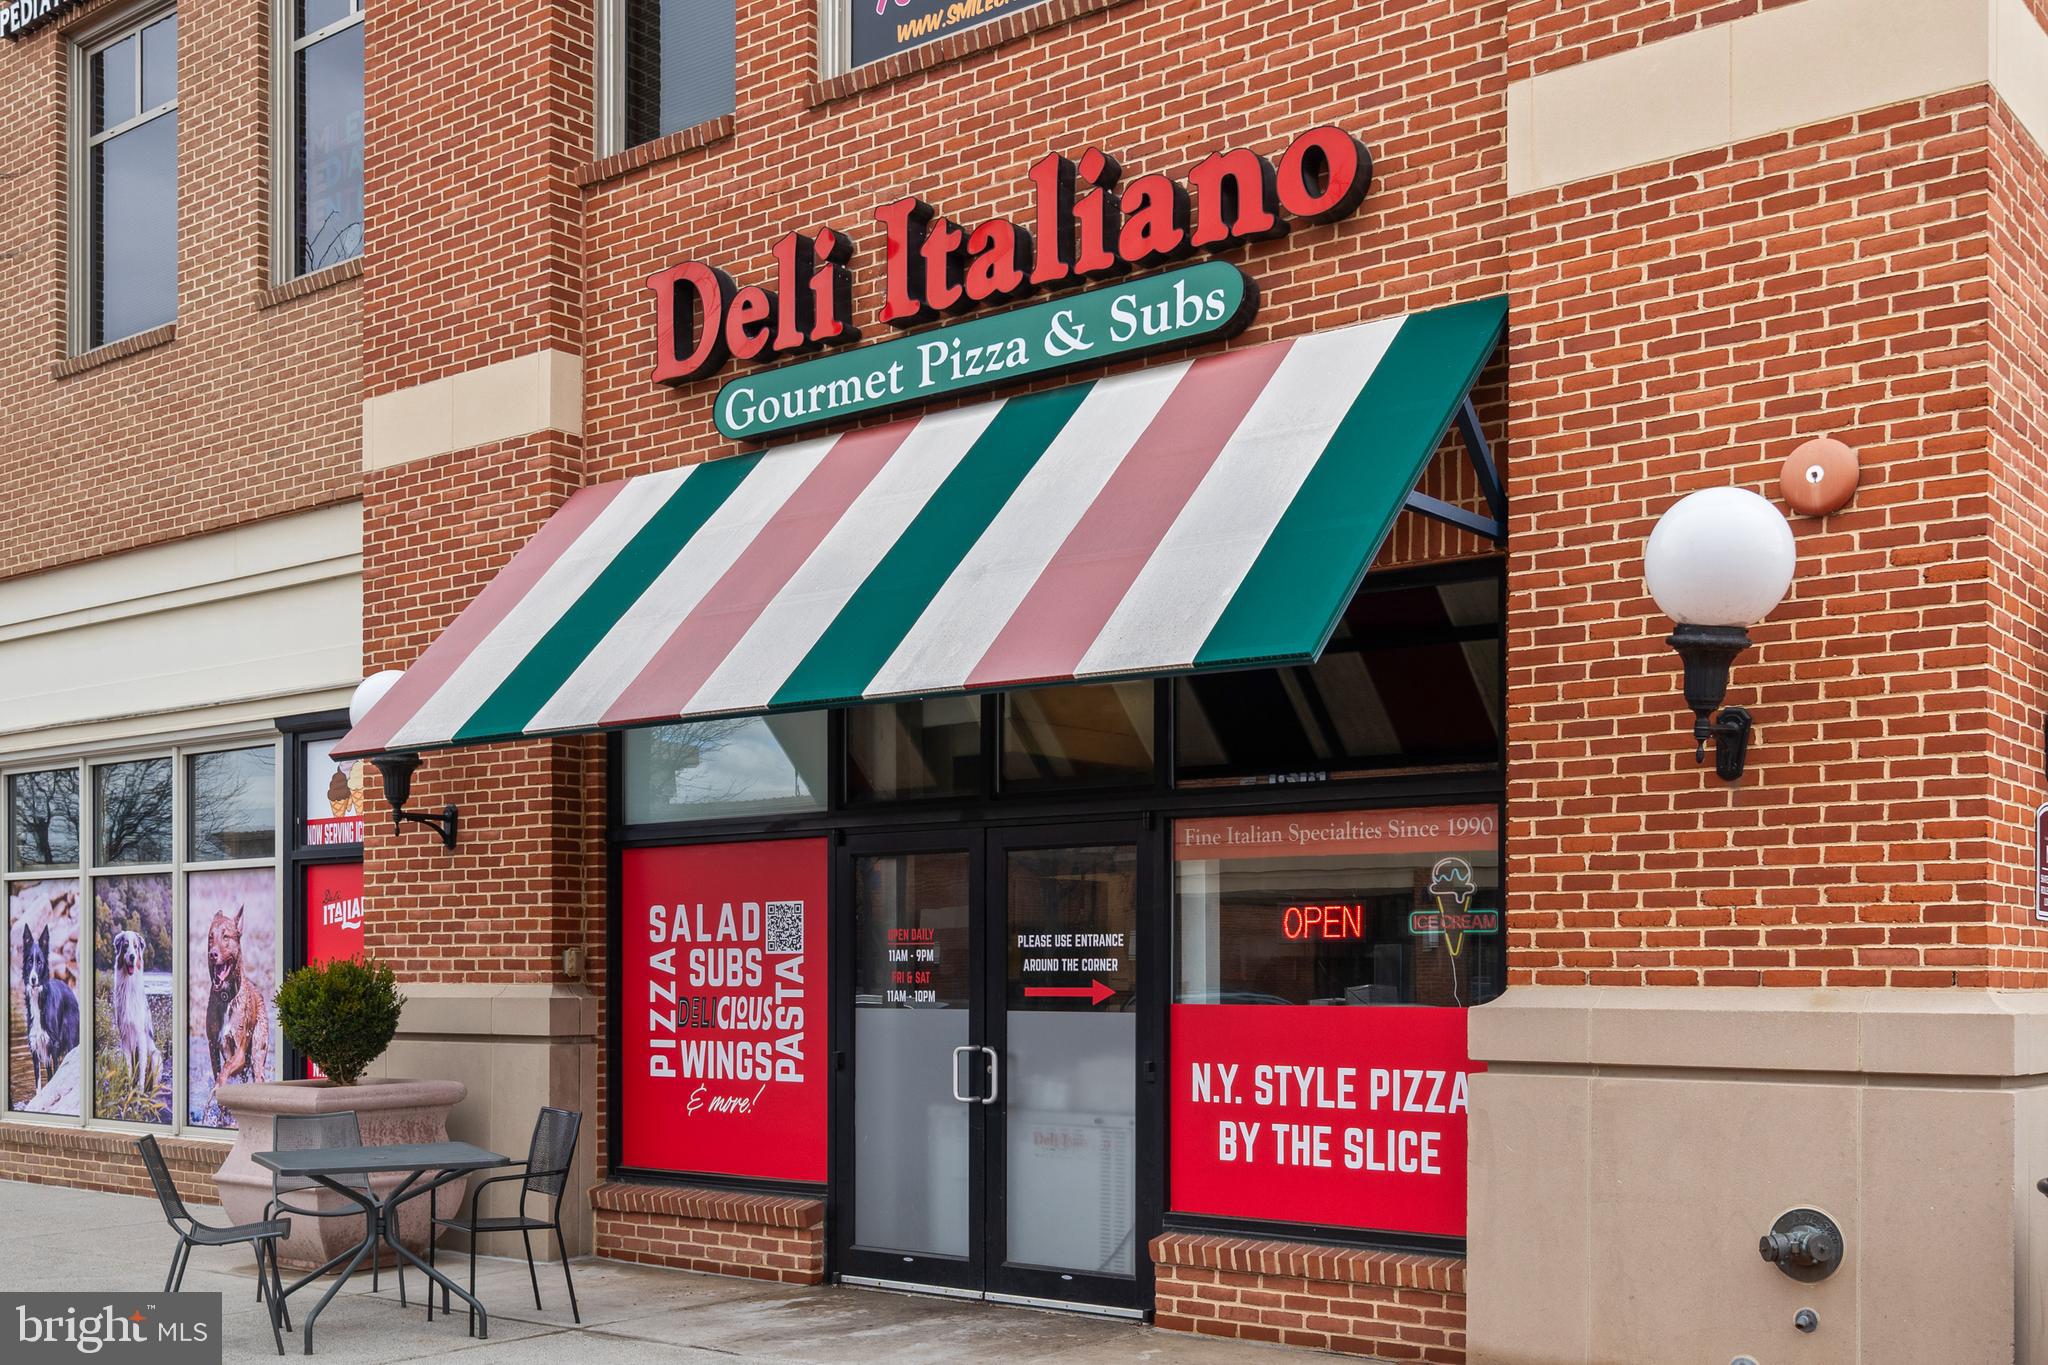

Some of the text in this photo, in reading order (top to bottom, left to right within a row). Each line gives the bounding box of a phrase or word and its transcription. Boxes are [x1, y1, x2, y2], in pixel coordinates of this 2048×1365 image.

[0, 0, 67, 36] PEDIA
[646, 125, 1364, 386] Deli Italiano
[725, 278, 1226, 431] Gourmet Pizza & Subs
[307, 824, 323, 846] NOW
[325, 821, 354, 845] SERVING
[1184, 816, 1494, 847] Fine Italian Specialties Since 1990
[649, 901, 761, 943] SALAD
[887, 928, 935, 941] OPEN DAILY
[1283, 905, 1362, 939] OPEN
[1413, 913, 1496, 930] ICE CREAM
[888, 949, 908, 962] 11AM
[916, 949, 934, 962] 9PM
[1017, 933, 1124, 948] PLEASE USE ENTRANCE
[689, 948, 763, 987] SUBS
[892, 971, 931, 984] FRI & SAT
[1023, 957, 1118, 972] AROUND THE CORNER
[650, 948, 676, 1078] PIZZA
[887, 990, 907, 1003] 11AM
[914, 990, 936, 1003] 10PM
[775, 955, 805, 1083] PASTA
[681, 1040, 773, 1081] WINGS
[686, 1083, 766, 1116] & more!
[1191, 1062, 1468, 1114] N.Y. STYLE PIZZA
[1218, 1120, 1441, 1175] BY THE SLICE
